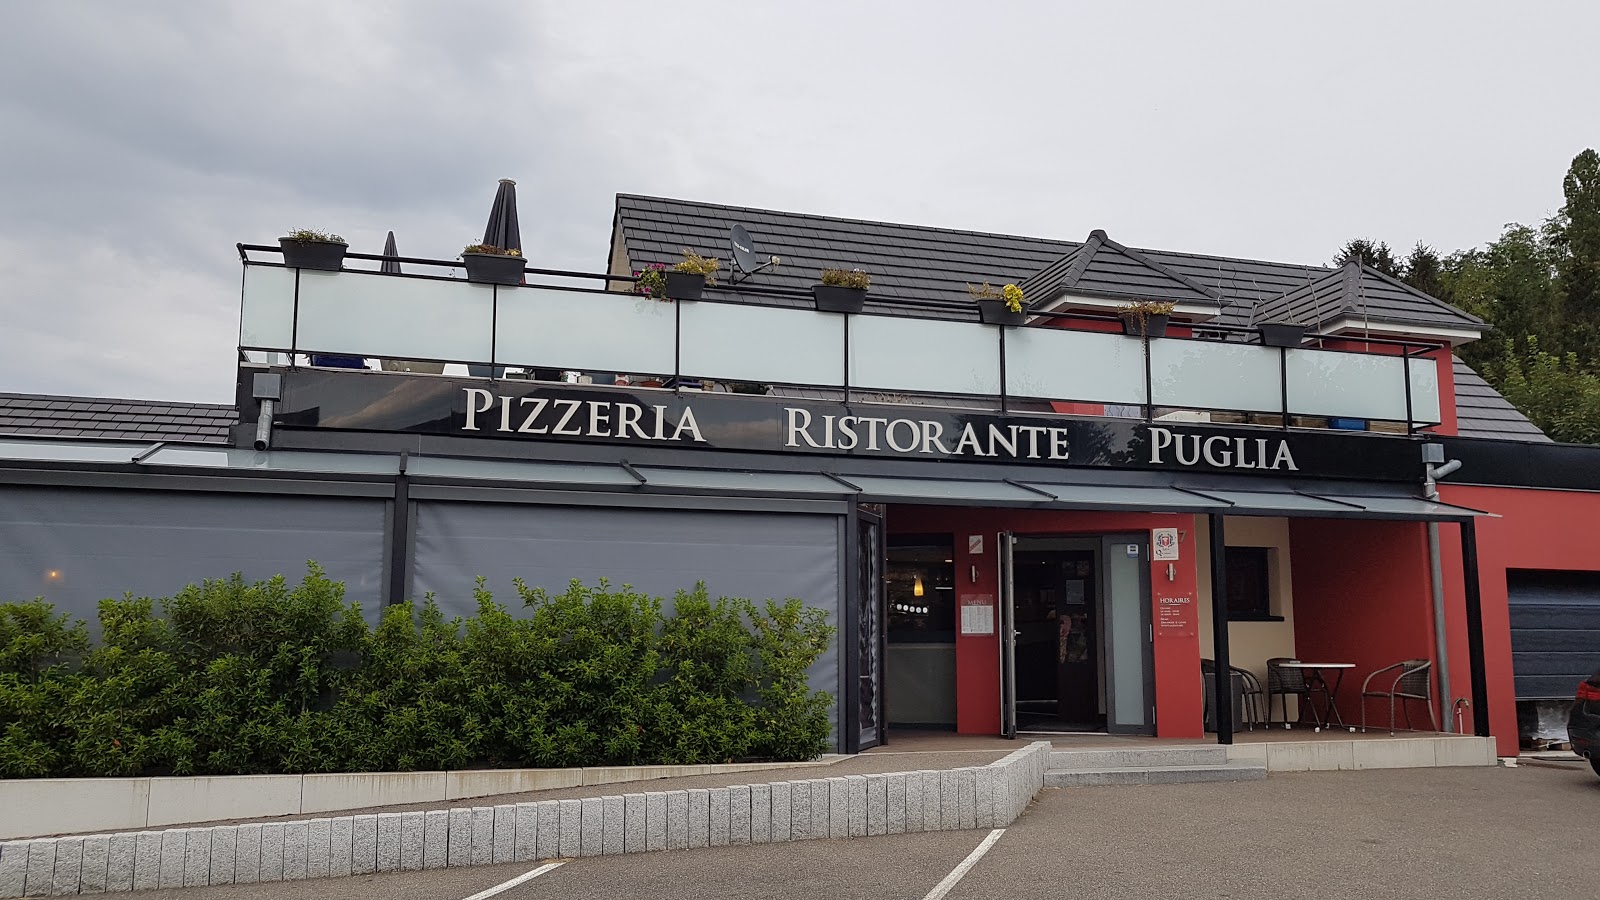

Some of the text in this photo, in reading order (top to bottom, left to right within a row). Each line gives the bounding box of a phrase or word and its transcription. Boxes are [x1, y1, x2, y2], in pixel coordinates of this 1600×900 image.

[461, 387, 1300, 471] PIZZERIA RISTORANTE PUGLIA
[1178, 529, 1187, 543] 7
